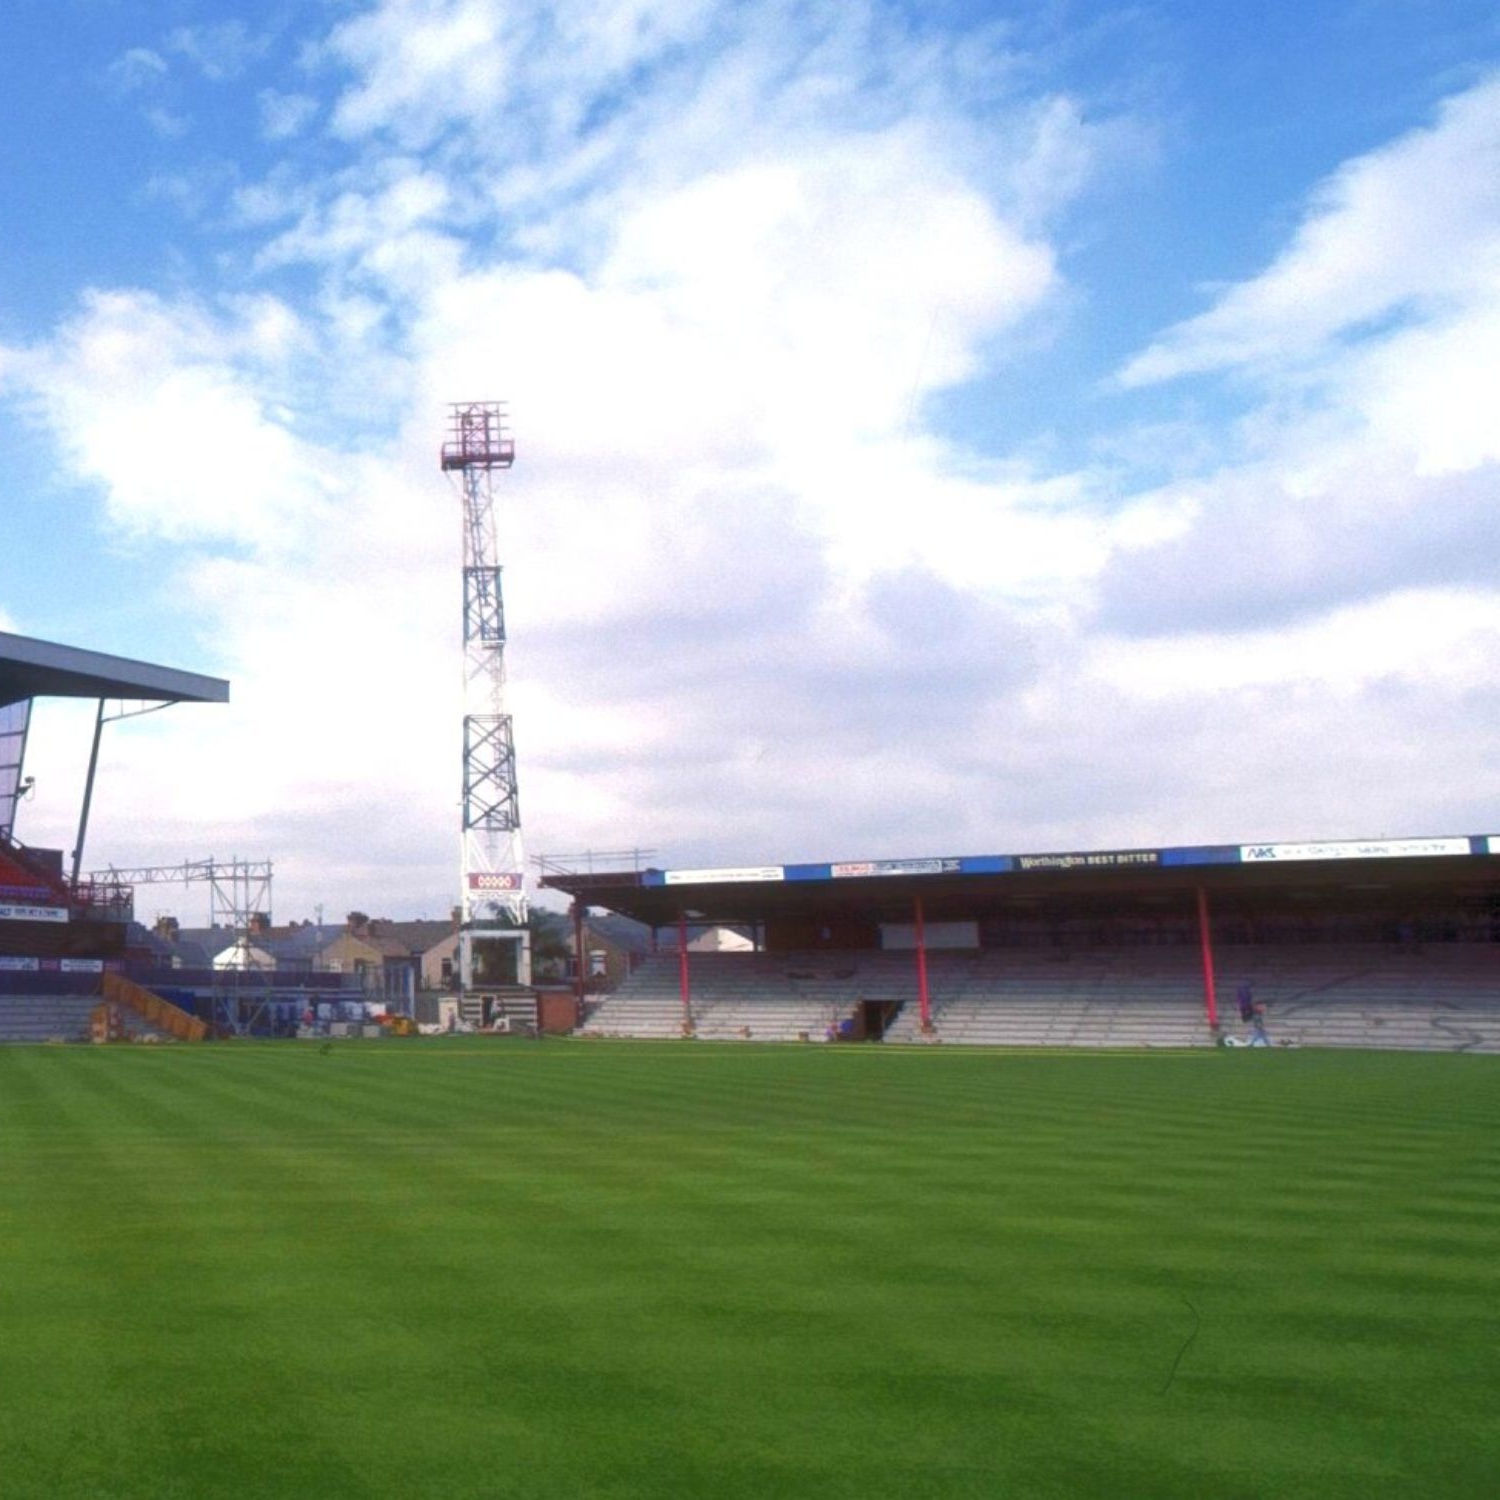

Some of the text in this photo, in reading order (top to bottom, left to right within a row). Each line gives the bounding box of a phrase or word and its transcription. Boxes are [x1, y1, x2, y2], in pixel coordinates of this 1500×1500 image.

[1019, 853, 1158, 869] Worthington BEST BITTER
